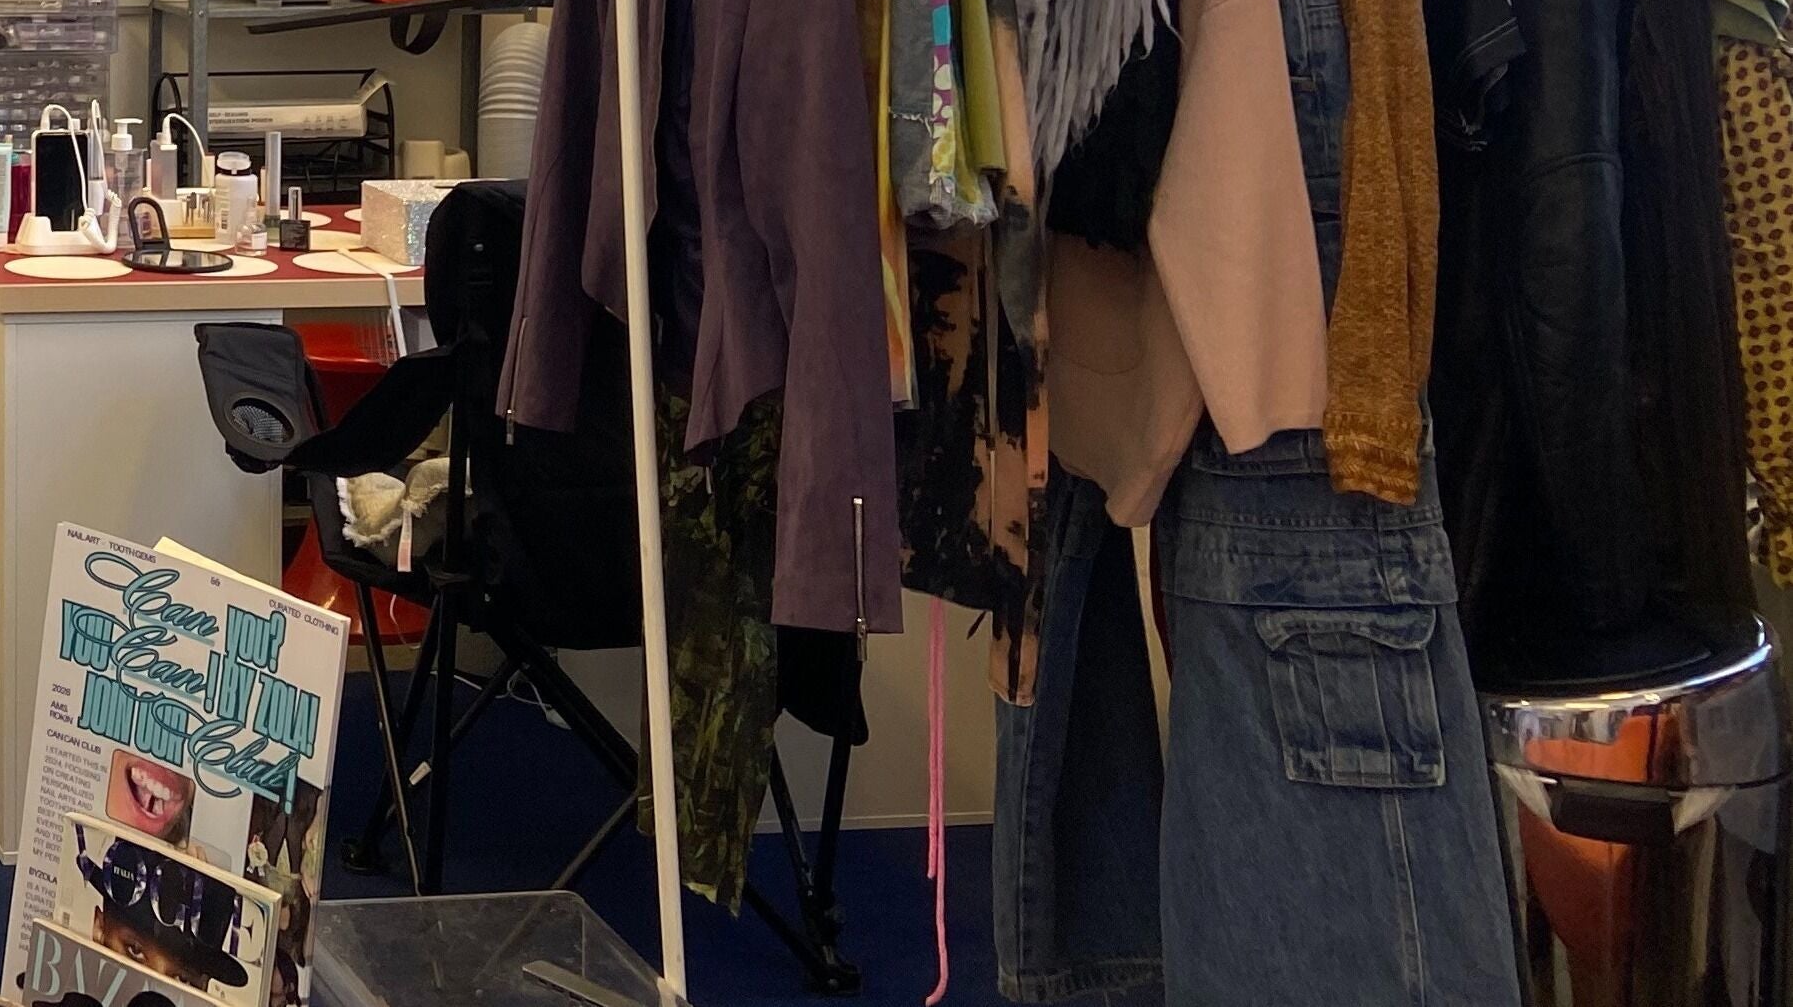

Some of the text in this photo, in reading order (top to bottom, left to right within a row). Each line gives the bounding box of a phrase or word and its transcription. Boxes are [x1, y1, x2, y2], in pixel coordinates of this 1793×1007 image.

[85, 552, 286, 673] Can YOU?
[269, 599, 339, 635] CURATED CLOTHING
[60, 599, 115, 672] YOU
[217, 651, 258, 728] BY
[252, 671, 322, 759] ZOLA!
[77, 671, 138, 746] JOIN
[133, 692, 190, 768] OUR
[81, 741, 102, 754] CLUB
[35, 816, 63, 833] EVERYO
[113, 865, 135, 881] ITALIA
